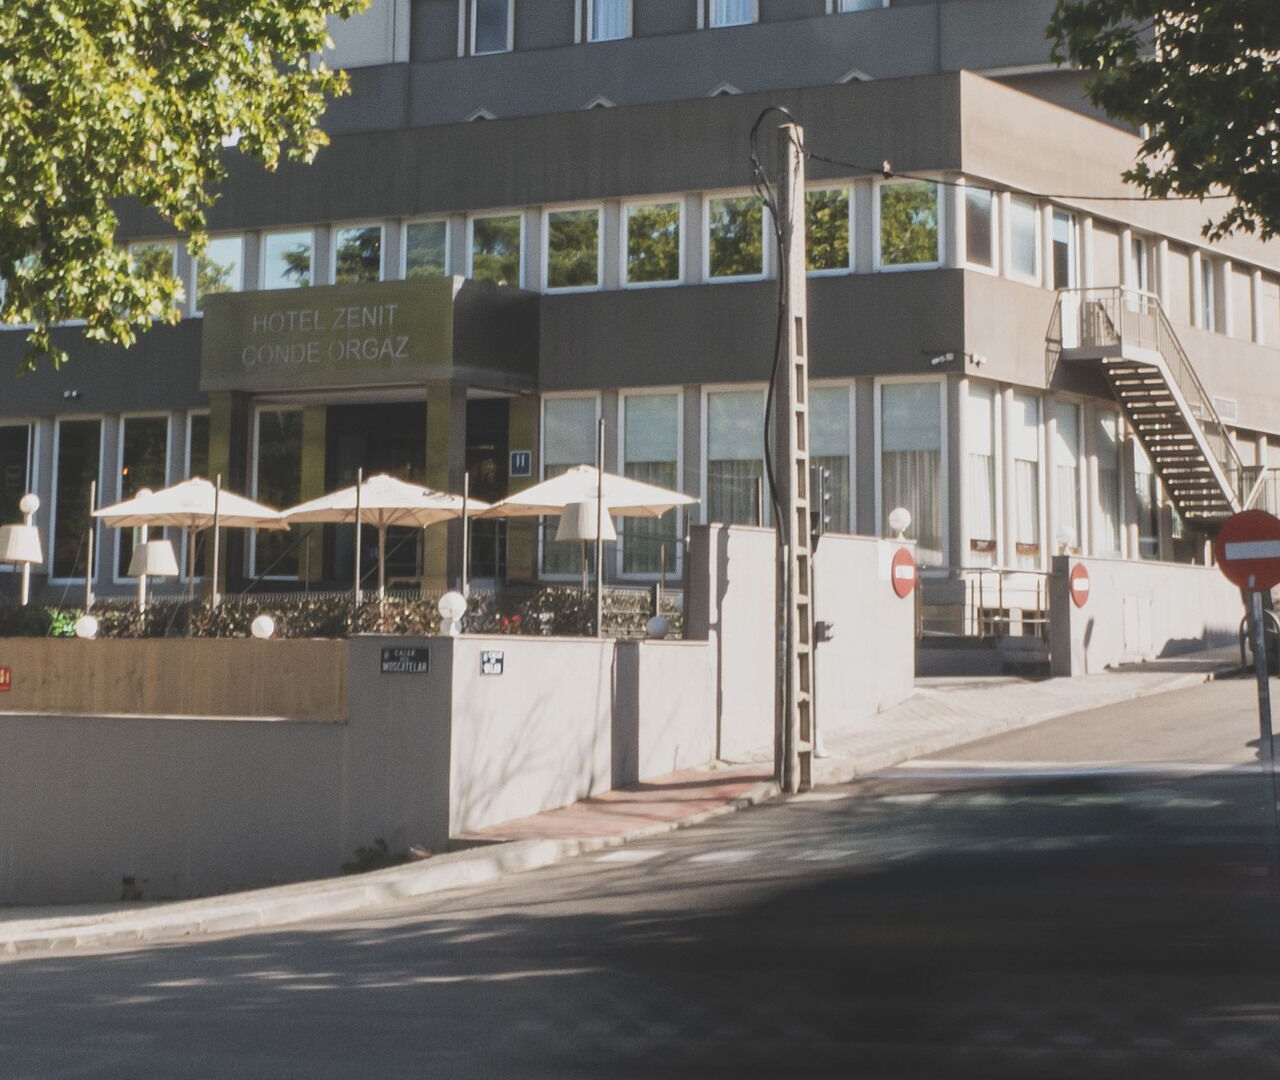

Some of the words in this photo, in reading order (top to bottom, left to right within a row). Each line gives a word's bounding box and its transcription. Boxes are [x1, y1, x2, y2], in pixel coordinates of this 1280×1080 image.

[253, 310, 324, 333] HOTEL
[332, 304, 399, 330] ZENIT
[241, 342, 320, 367] CONDE
[328, 335, 410, 362] ORGAZ
[382, 661, 427, 672] MOSCATELAR
